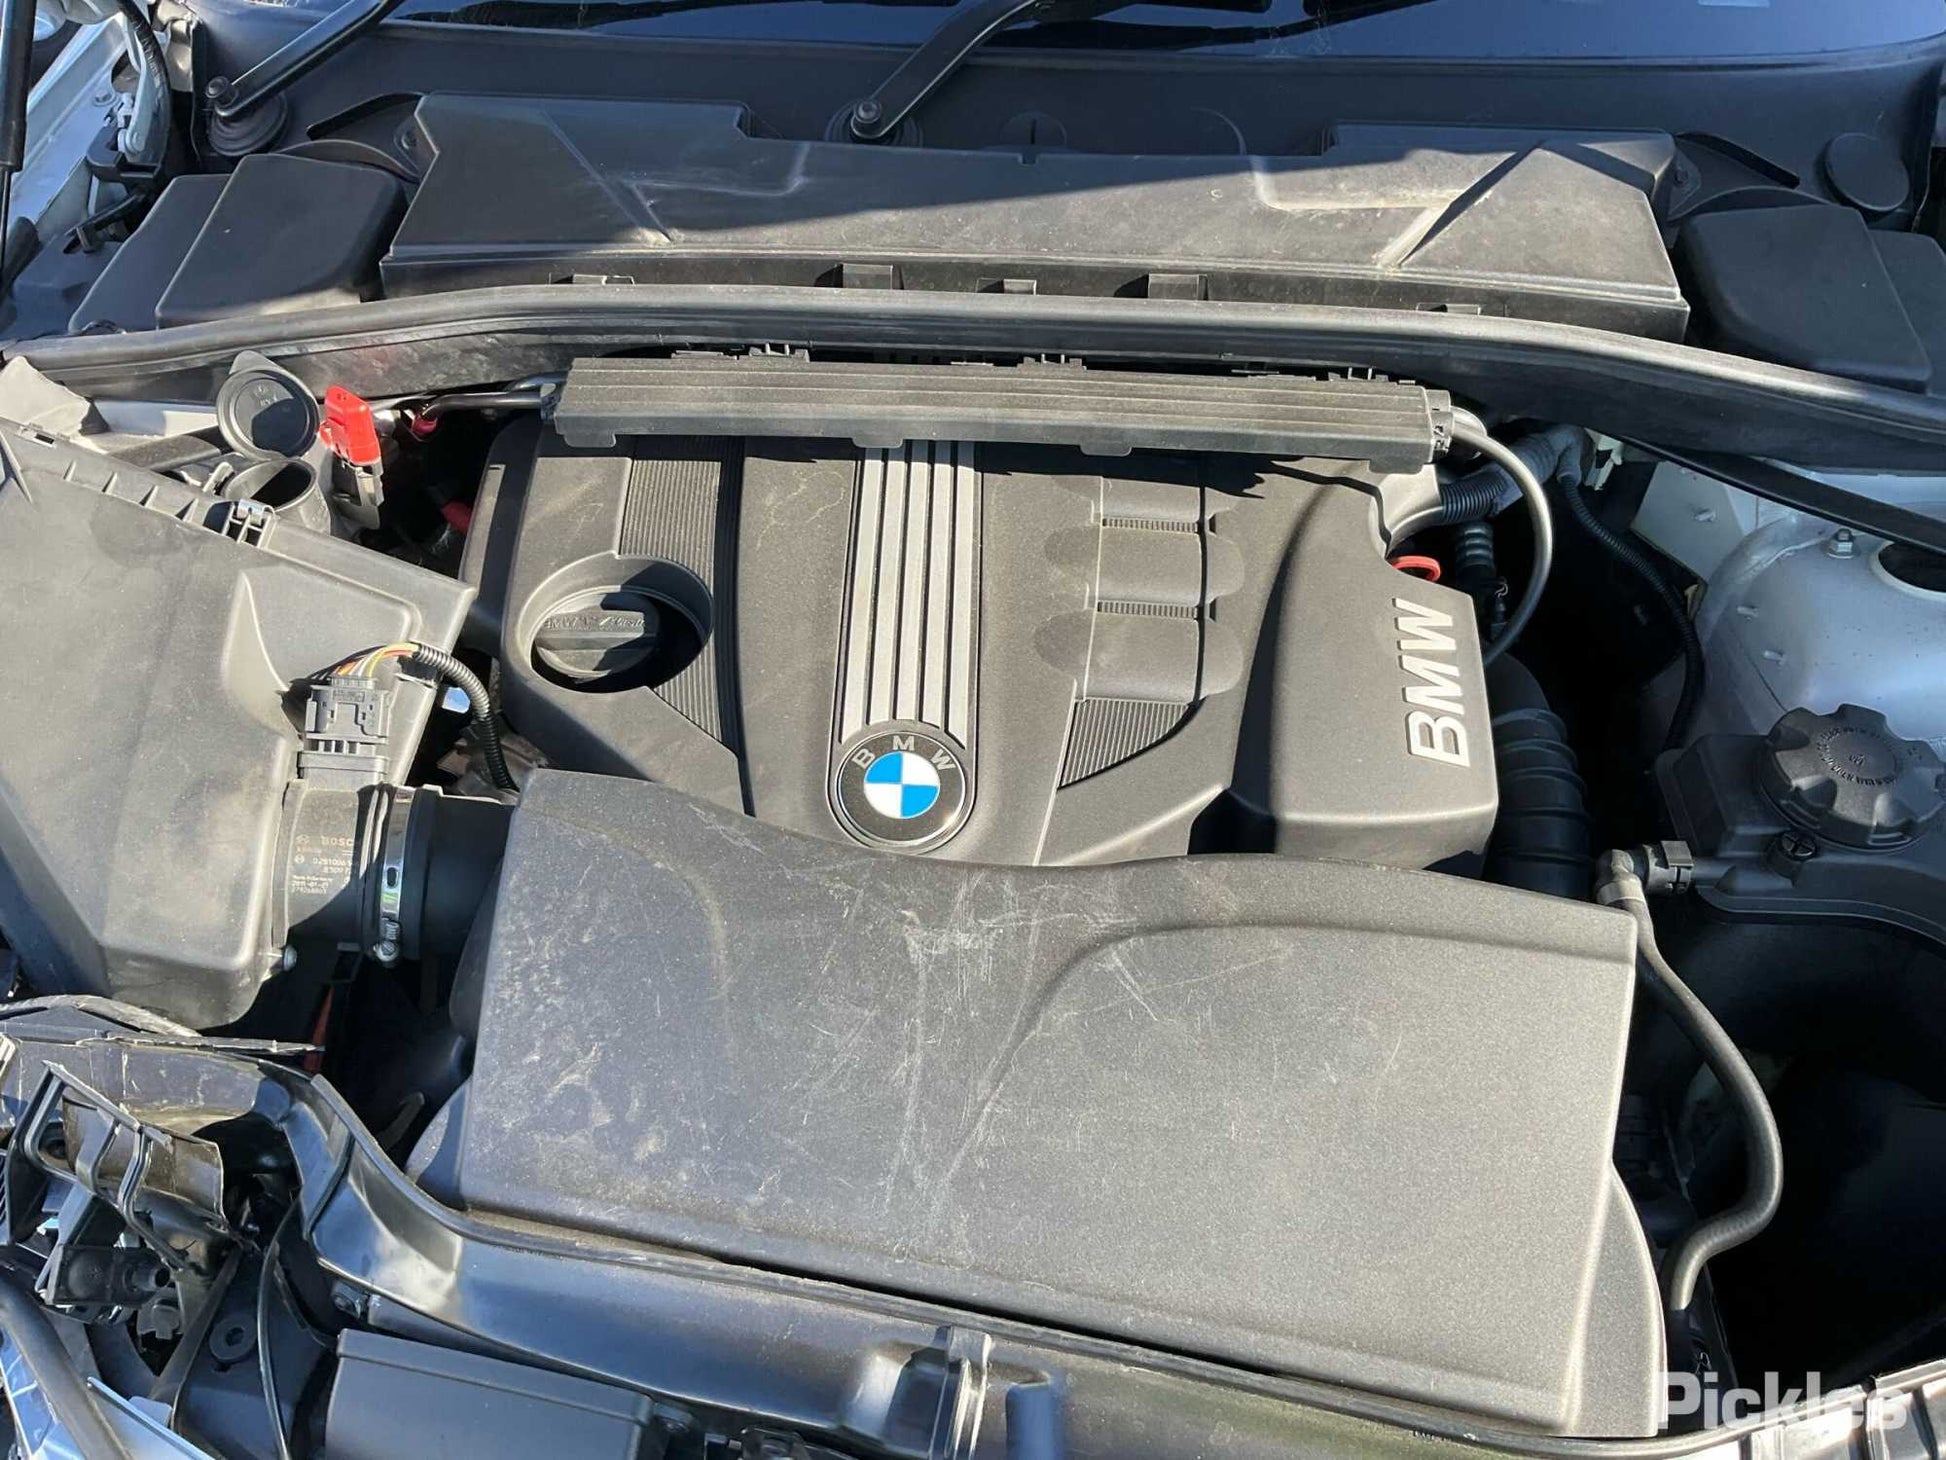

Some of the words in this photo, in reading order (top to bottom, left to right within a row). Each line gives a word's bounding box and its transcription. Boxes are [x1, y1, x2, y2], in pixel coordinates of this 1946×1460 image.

[1393, 597, 1470, 767] BMW
[852, 735, 956, 771] BMW
[320, 835, 354, 847] BOSC
